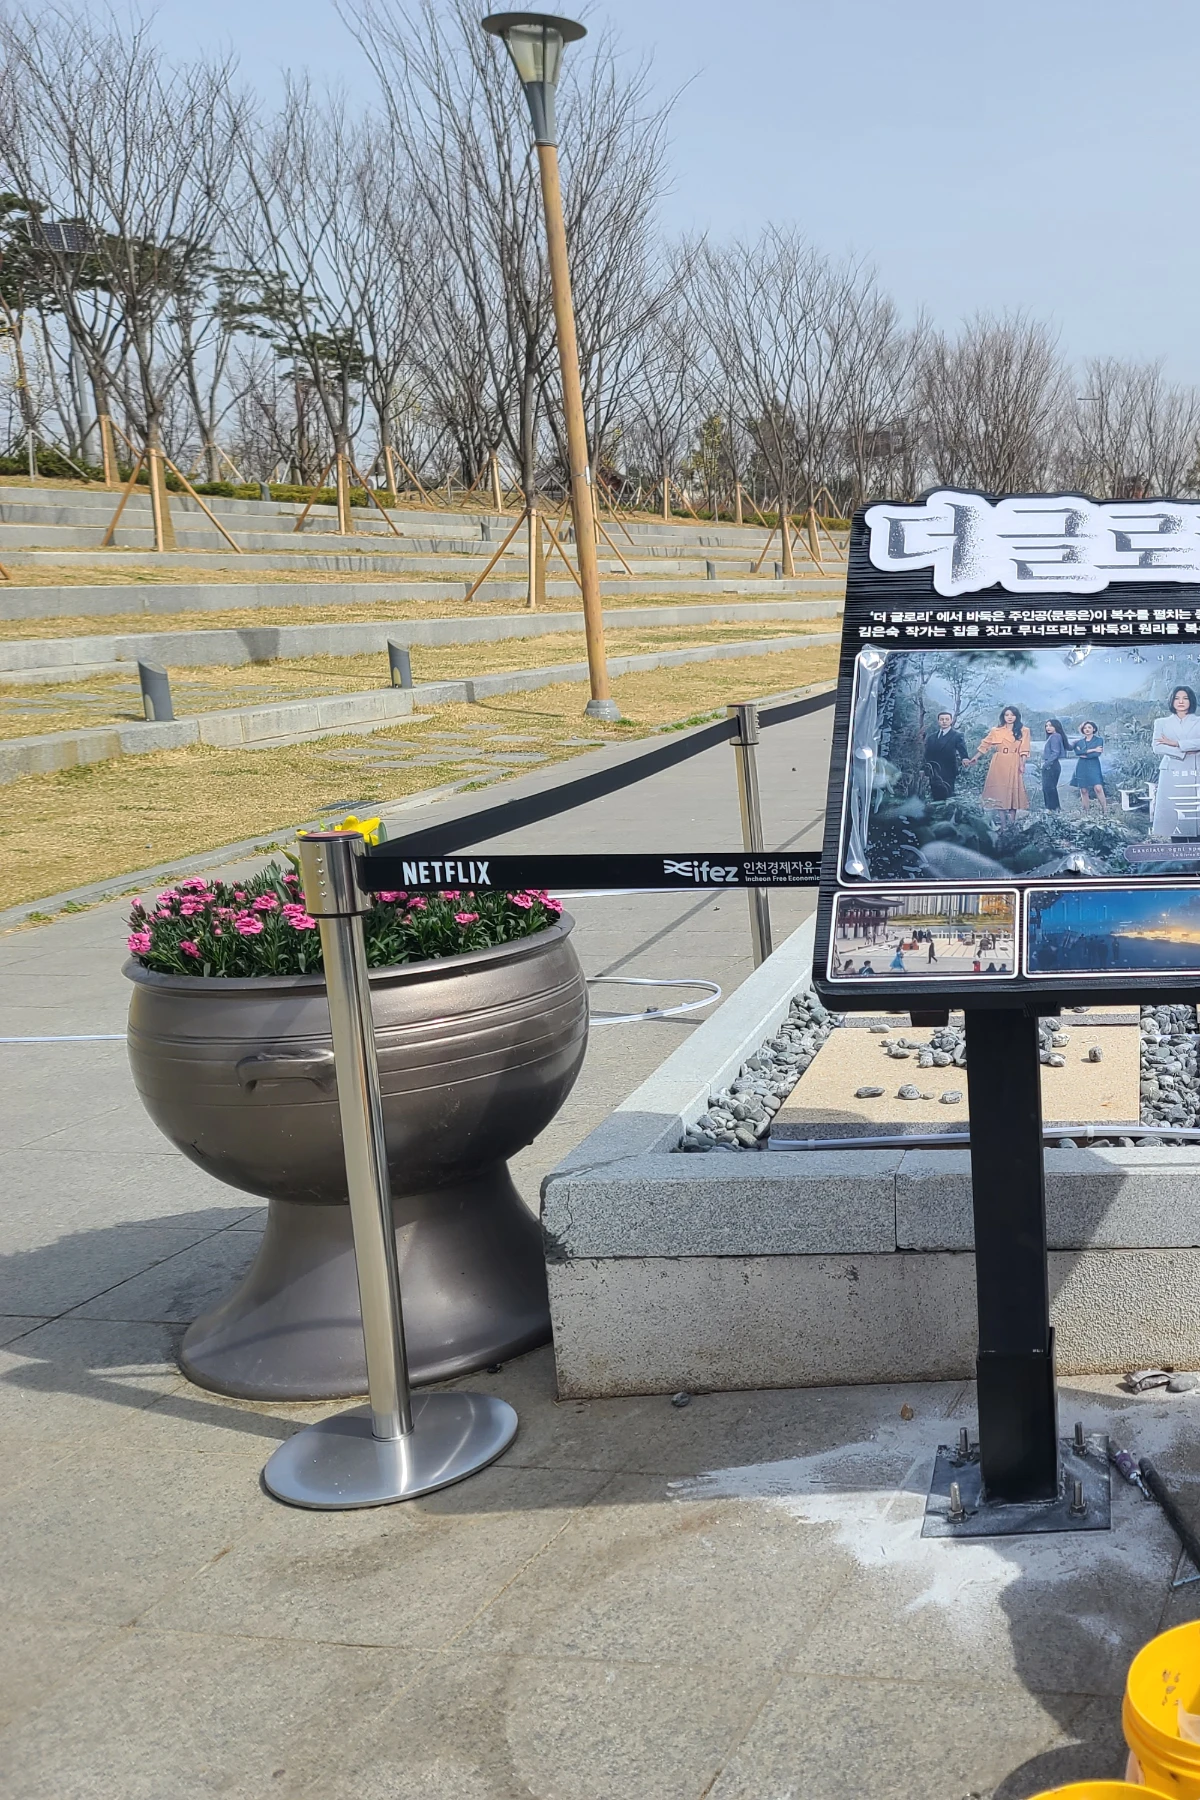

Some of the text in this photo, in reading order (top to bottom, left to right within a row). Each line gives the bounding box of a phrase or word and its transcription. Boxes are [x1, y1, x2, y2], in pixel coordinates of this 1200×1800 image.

[936, 611, 963, 622] 에서
[966, 610, 1006, 622] 바둑은
[1008, 609, 1107, 622] 주인공(문동은)이
[1110, 609, 1150, 621] 복수를
[1153, 609, 1192, 621] 펼치는
[858, 626, 899, 638] 김은숙
[905, 626, 947, 638] 작가는
[952, 625, 980, 637] 집을
[985, 625, 1013, 637] 짓고
[1017, 624, 1087, 637] 무너뜨리는
[1092, 622, 1132, 635] 바둑의
[1138, 622, 1179, 635] 원리를
[402, 861, 491, 886] NETFLIX
[693, 861, 739, 882] ifez
